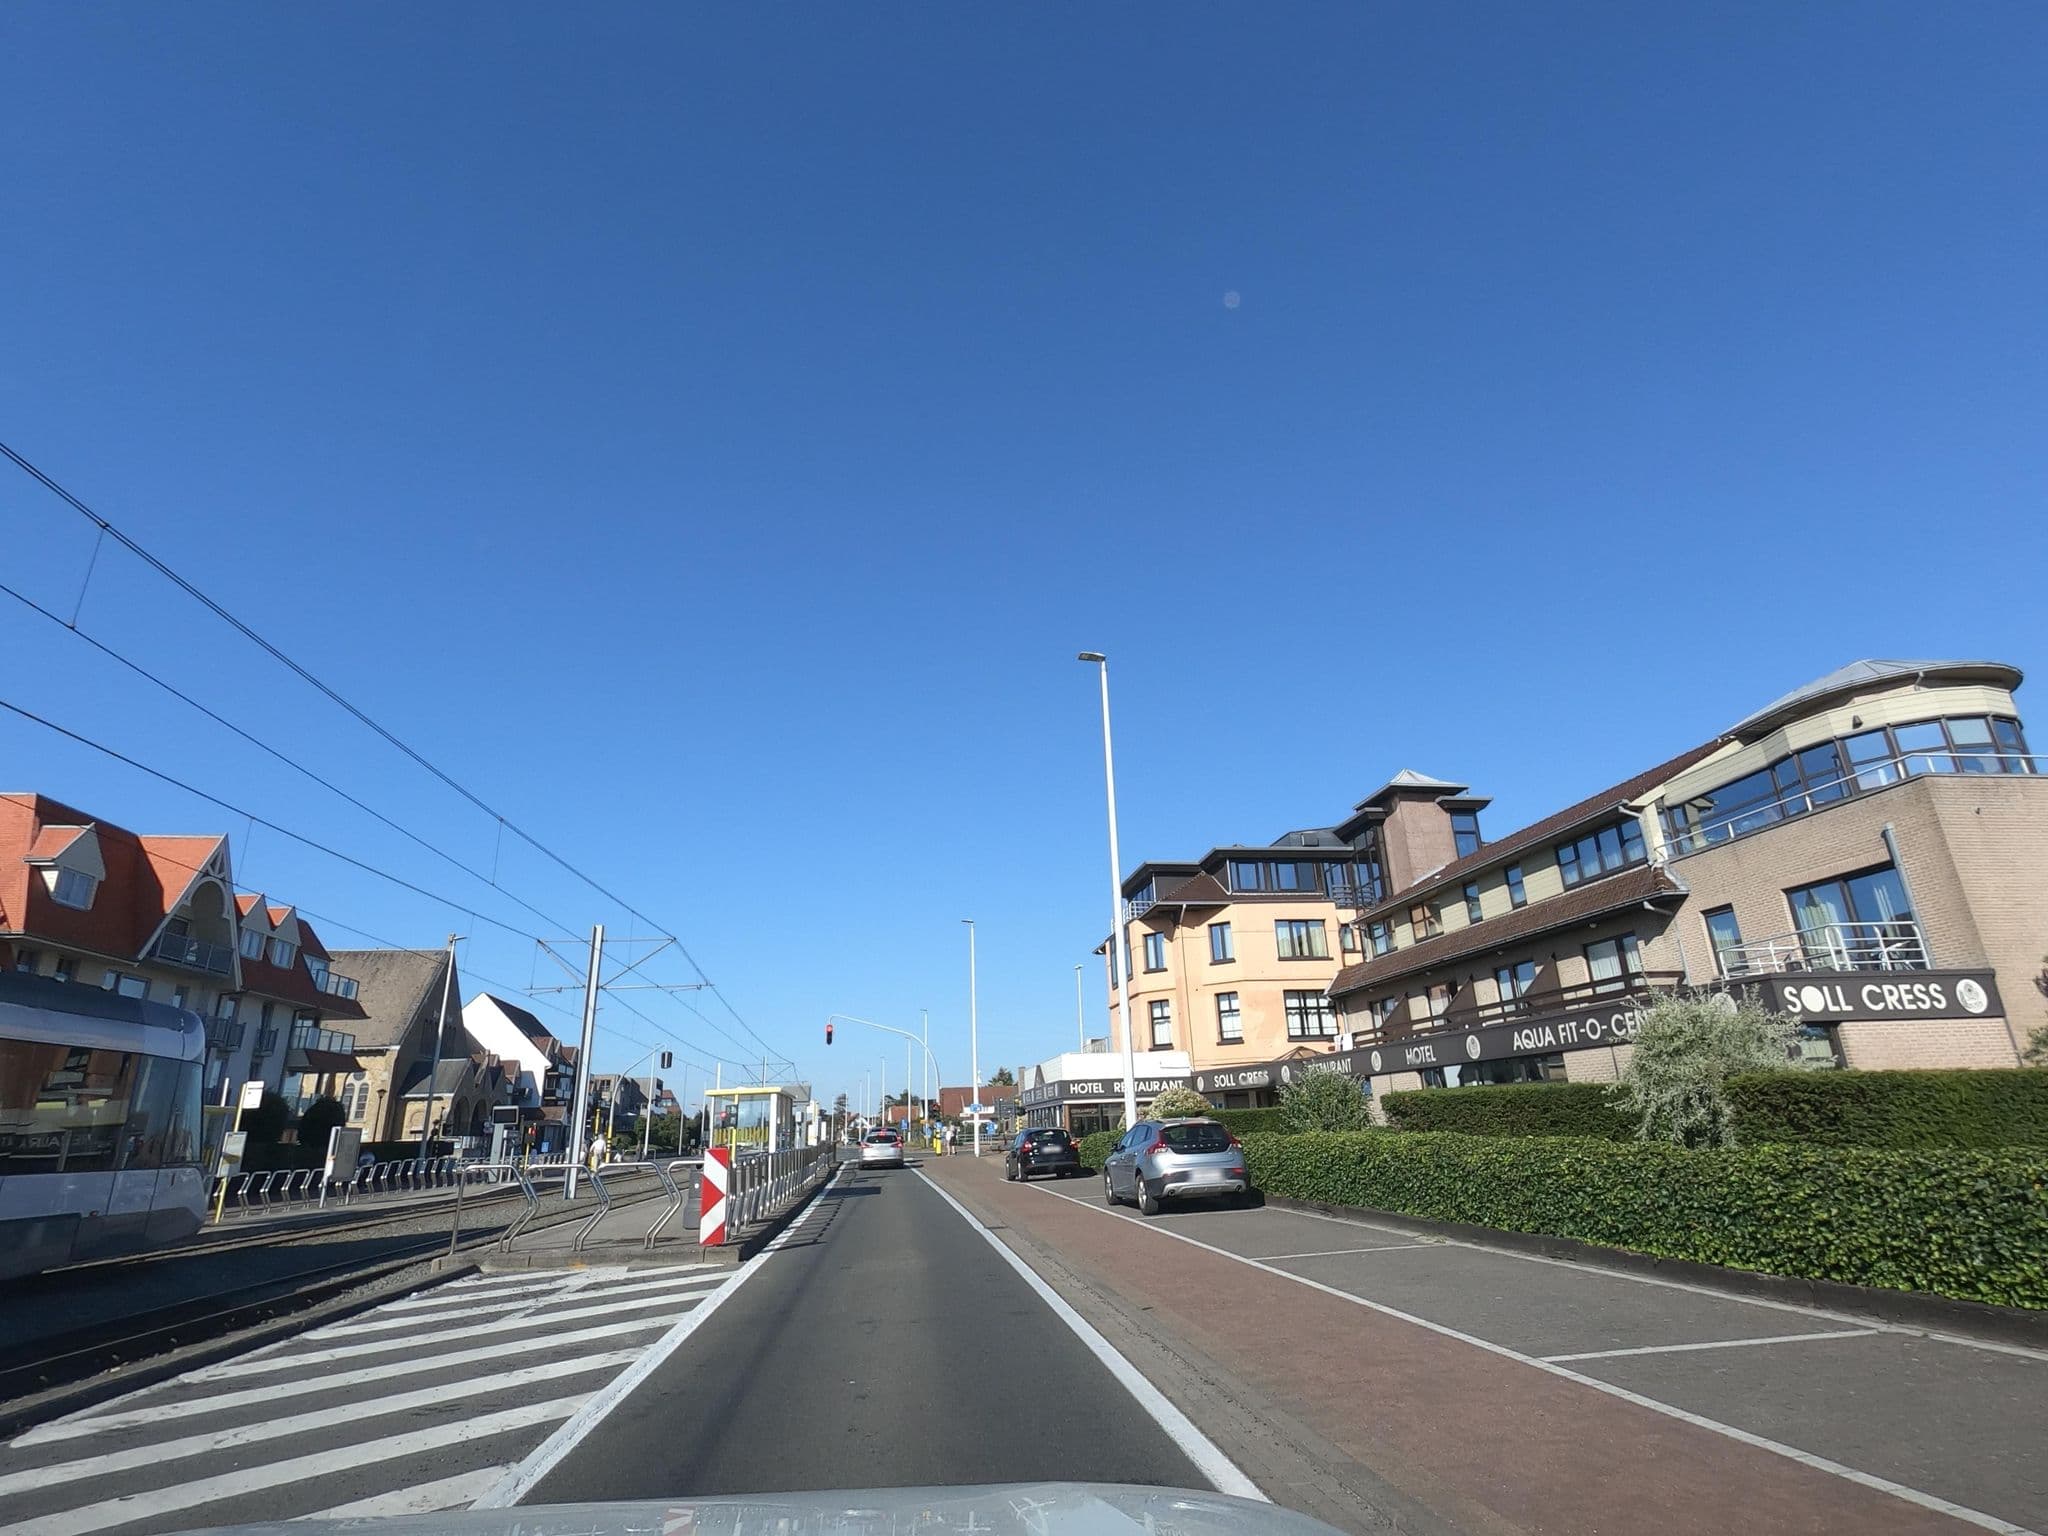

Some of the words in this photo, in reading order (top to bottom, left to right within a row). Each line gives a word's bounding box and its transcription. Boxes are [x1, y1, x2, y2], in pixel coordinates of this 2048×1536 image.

[1784, 985, 1854, 1013] SOLL
[1862, 983, 1947, 1012] CRESS
[1513, 1025, 1557, 1052] AQUA
[1405, 1044, 1437, 1065] HOTEL
[1069, 1082, 1105, 1094] HOTEL
[1113, 1079, 1184, 1093] RETAURANT
[1214, 1074, 1236, 1088] SOLL
